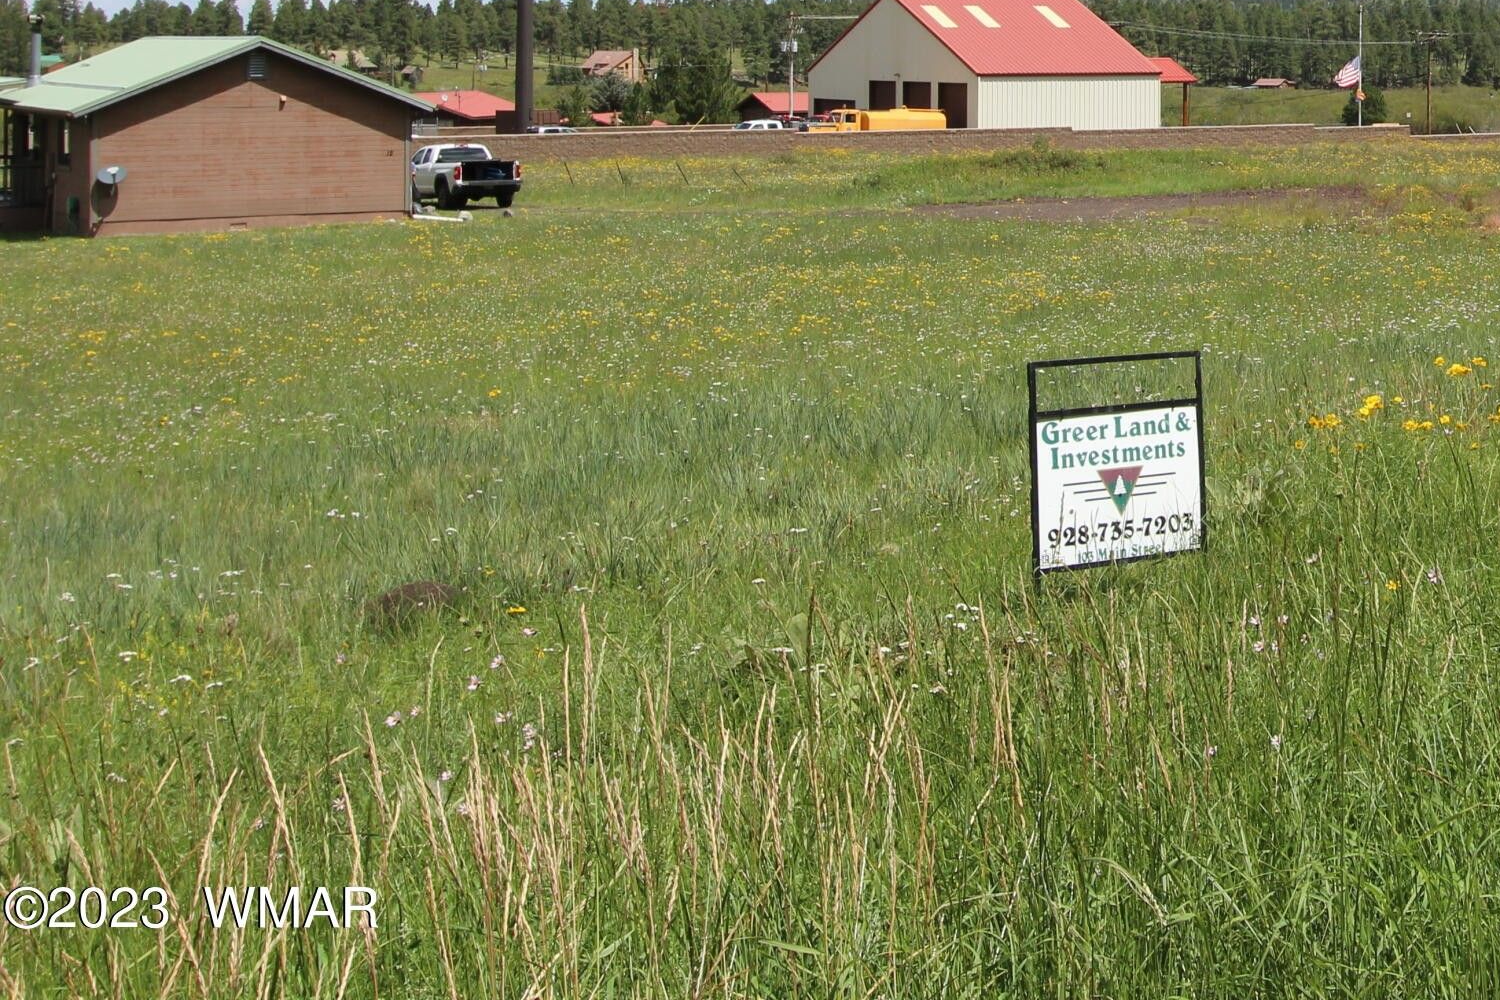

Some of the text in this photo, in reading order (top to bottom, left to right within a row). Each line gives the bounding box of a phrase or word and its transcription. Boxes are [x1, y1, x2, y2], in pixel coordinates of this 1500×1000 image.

[1042, 411, 1191, 445] Greer Land &
[1050, 440, 1185, 470] Investments
[1047, 512, 1193, 549] 928-735-7203
[1098, 546, 1127, 560] Min
[1131, 543, 1163, 557] Stree
